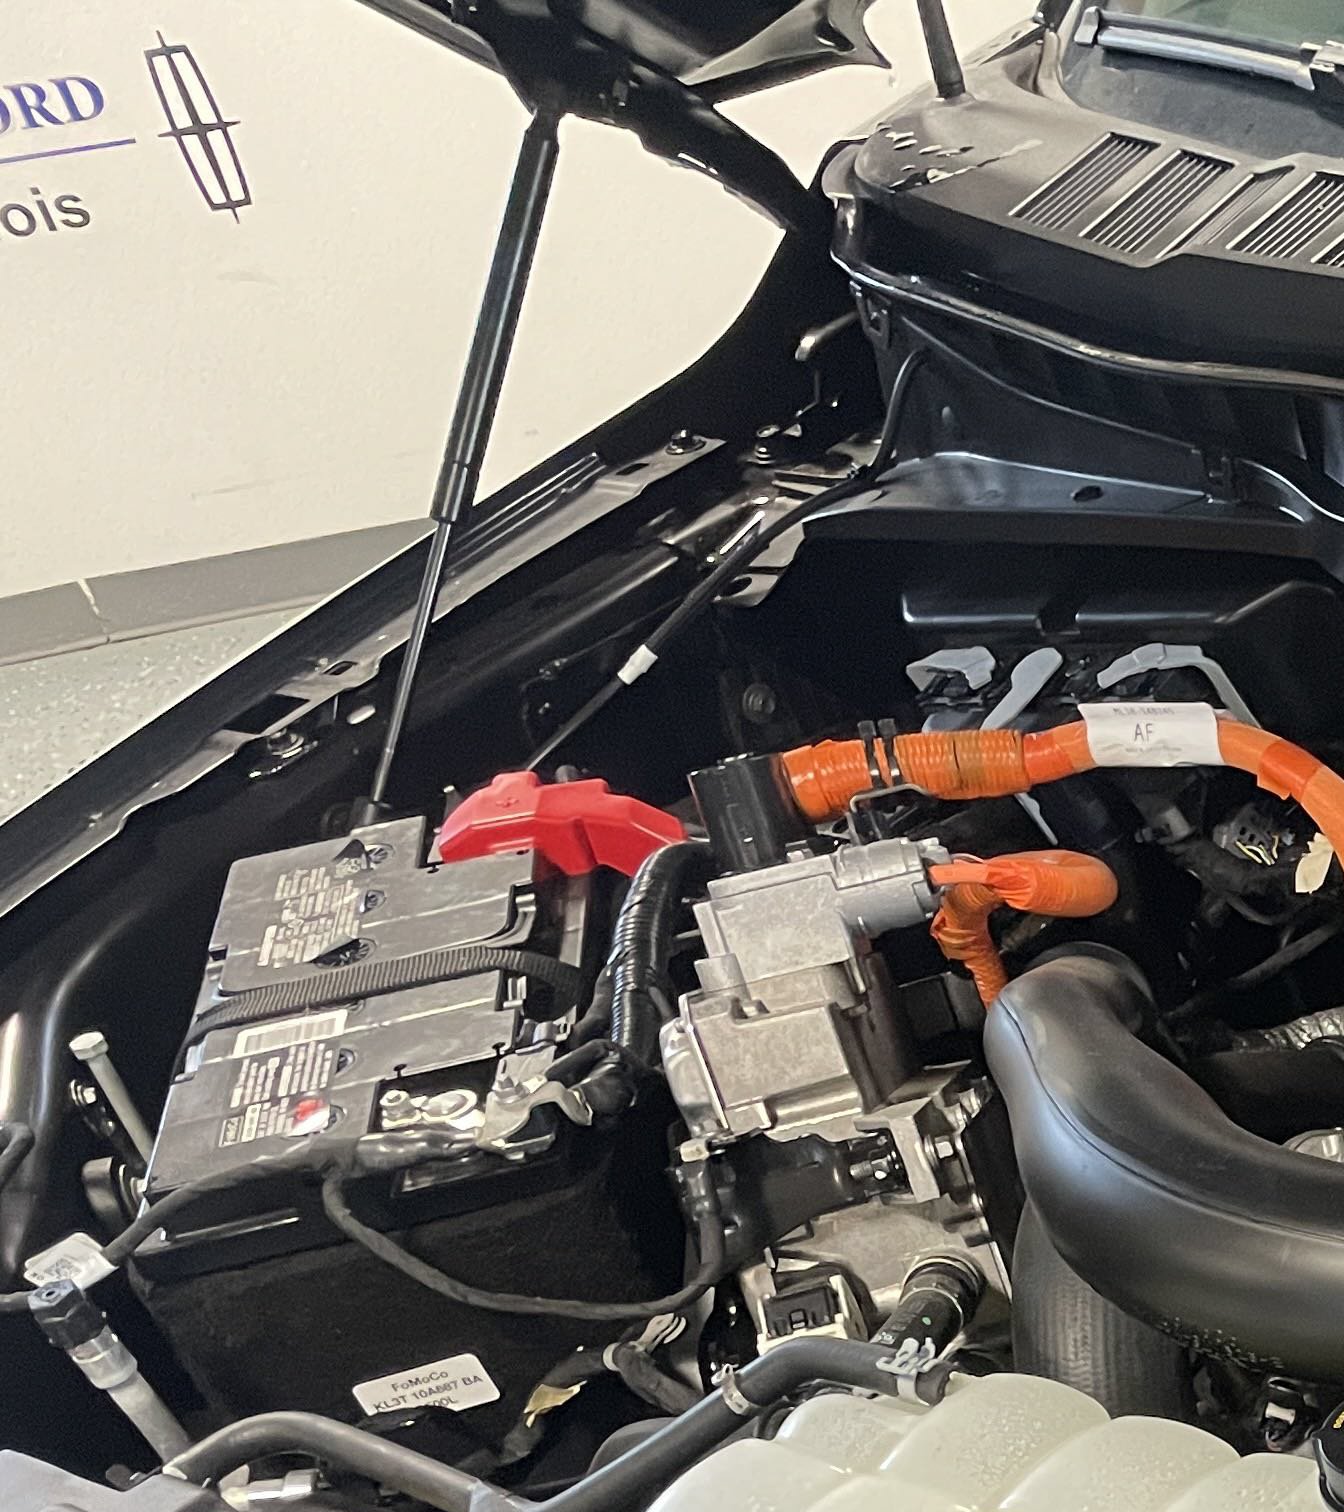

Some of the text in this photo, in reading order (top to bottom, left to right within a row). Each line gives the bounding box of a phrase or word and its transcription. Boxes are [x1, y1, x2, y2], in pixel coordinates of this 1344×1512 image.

[1134, 723, 1153, 742] AF
[392, 1371, 449, 1392] FoMoCo
[373, 1395, 408, 1411] KL3T
